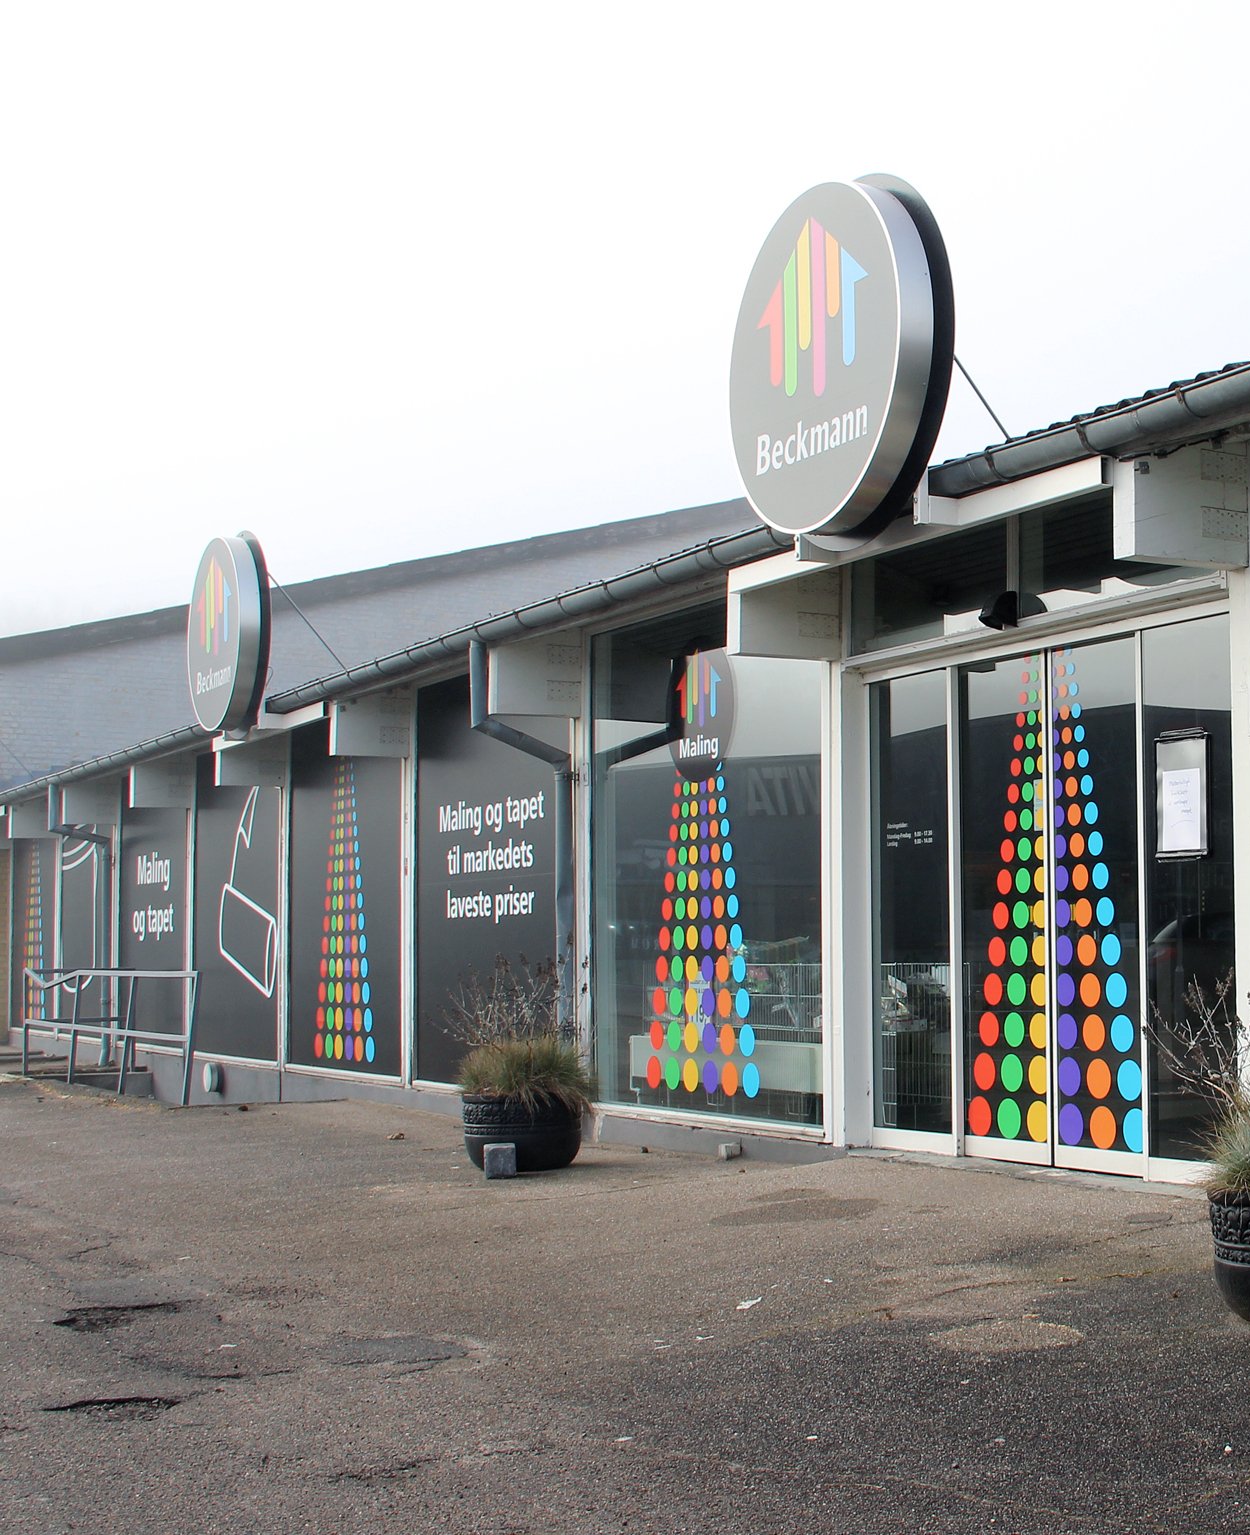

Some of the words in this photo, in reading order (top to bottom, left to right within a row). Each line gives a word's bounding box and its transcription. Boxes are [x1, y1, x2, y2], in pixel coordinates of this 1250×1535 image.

[756, 404, 868, 476] Beckmann
[196, 665, 231, 695] Beckmann
[679, 734, 719, 759] Maling
[439, 800, 482, 836] Maling
[485, 802, 503, 833] og
[506, 790, 545, 829] tapet
[137, 851, 171, 892] Maling
[447, 844, 460, 875] til
[463, 838, 534, 874] markedets
[132, 910, 146, 942] og
[147, 903, 175, 941] tapet
[446, 889, 492, 919] laveste
[494, 884, 535, 924] priser
